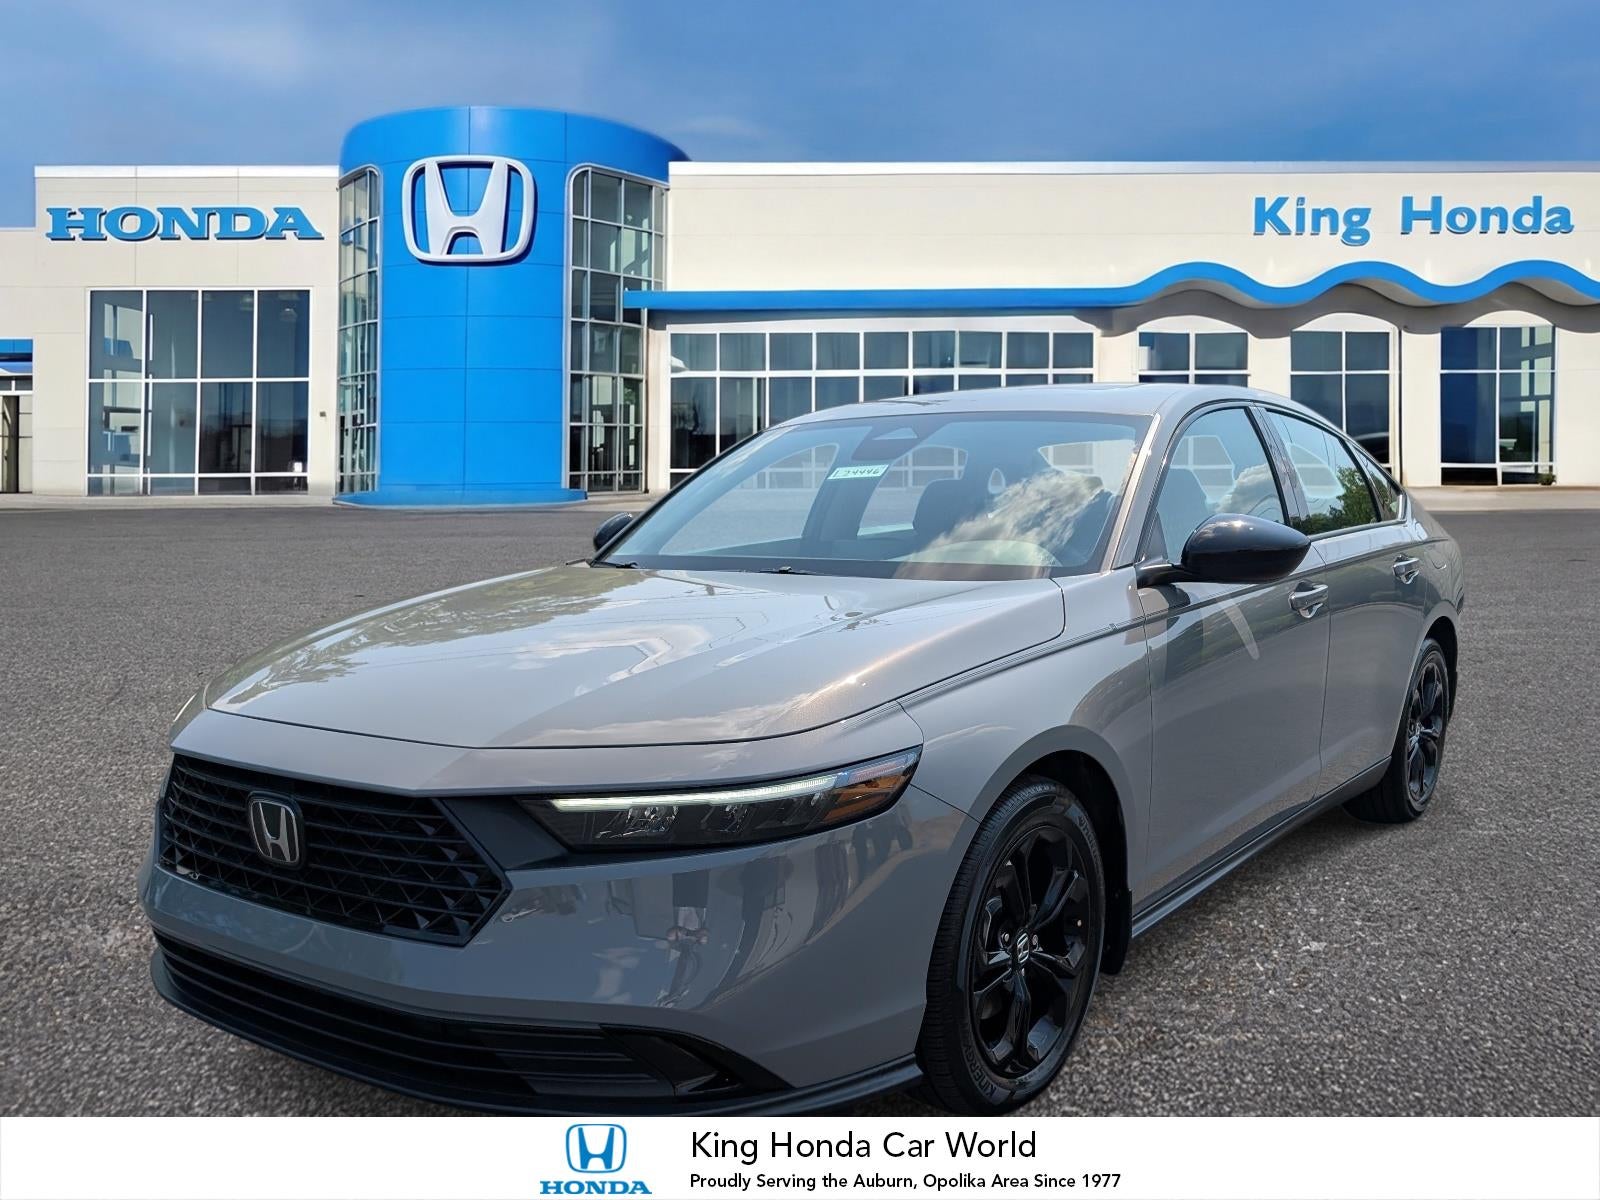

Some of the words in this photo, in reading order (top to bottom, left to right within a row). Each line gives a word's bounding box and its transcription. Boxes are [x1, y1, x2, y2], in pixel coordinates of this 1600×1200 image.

[46, 206, 324, 241] HONDA
[1253, 195, 1372, 246] King
[1400, 194, 1575, 234] Honda
